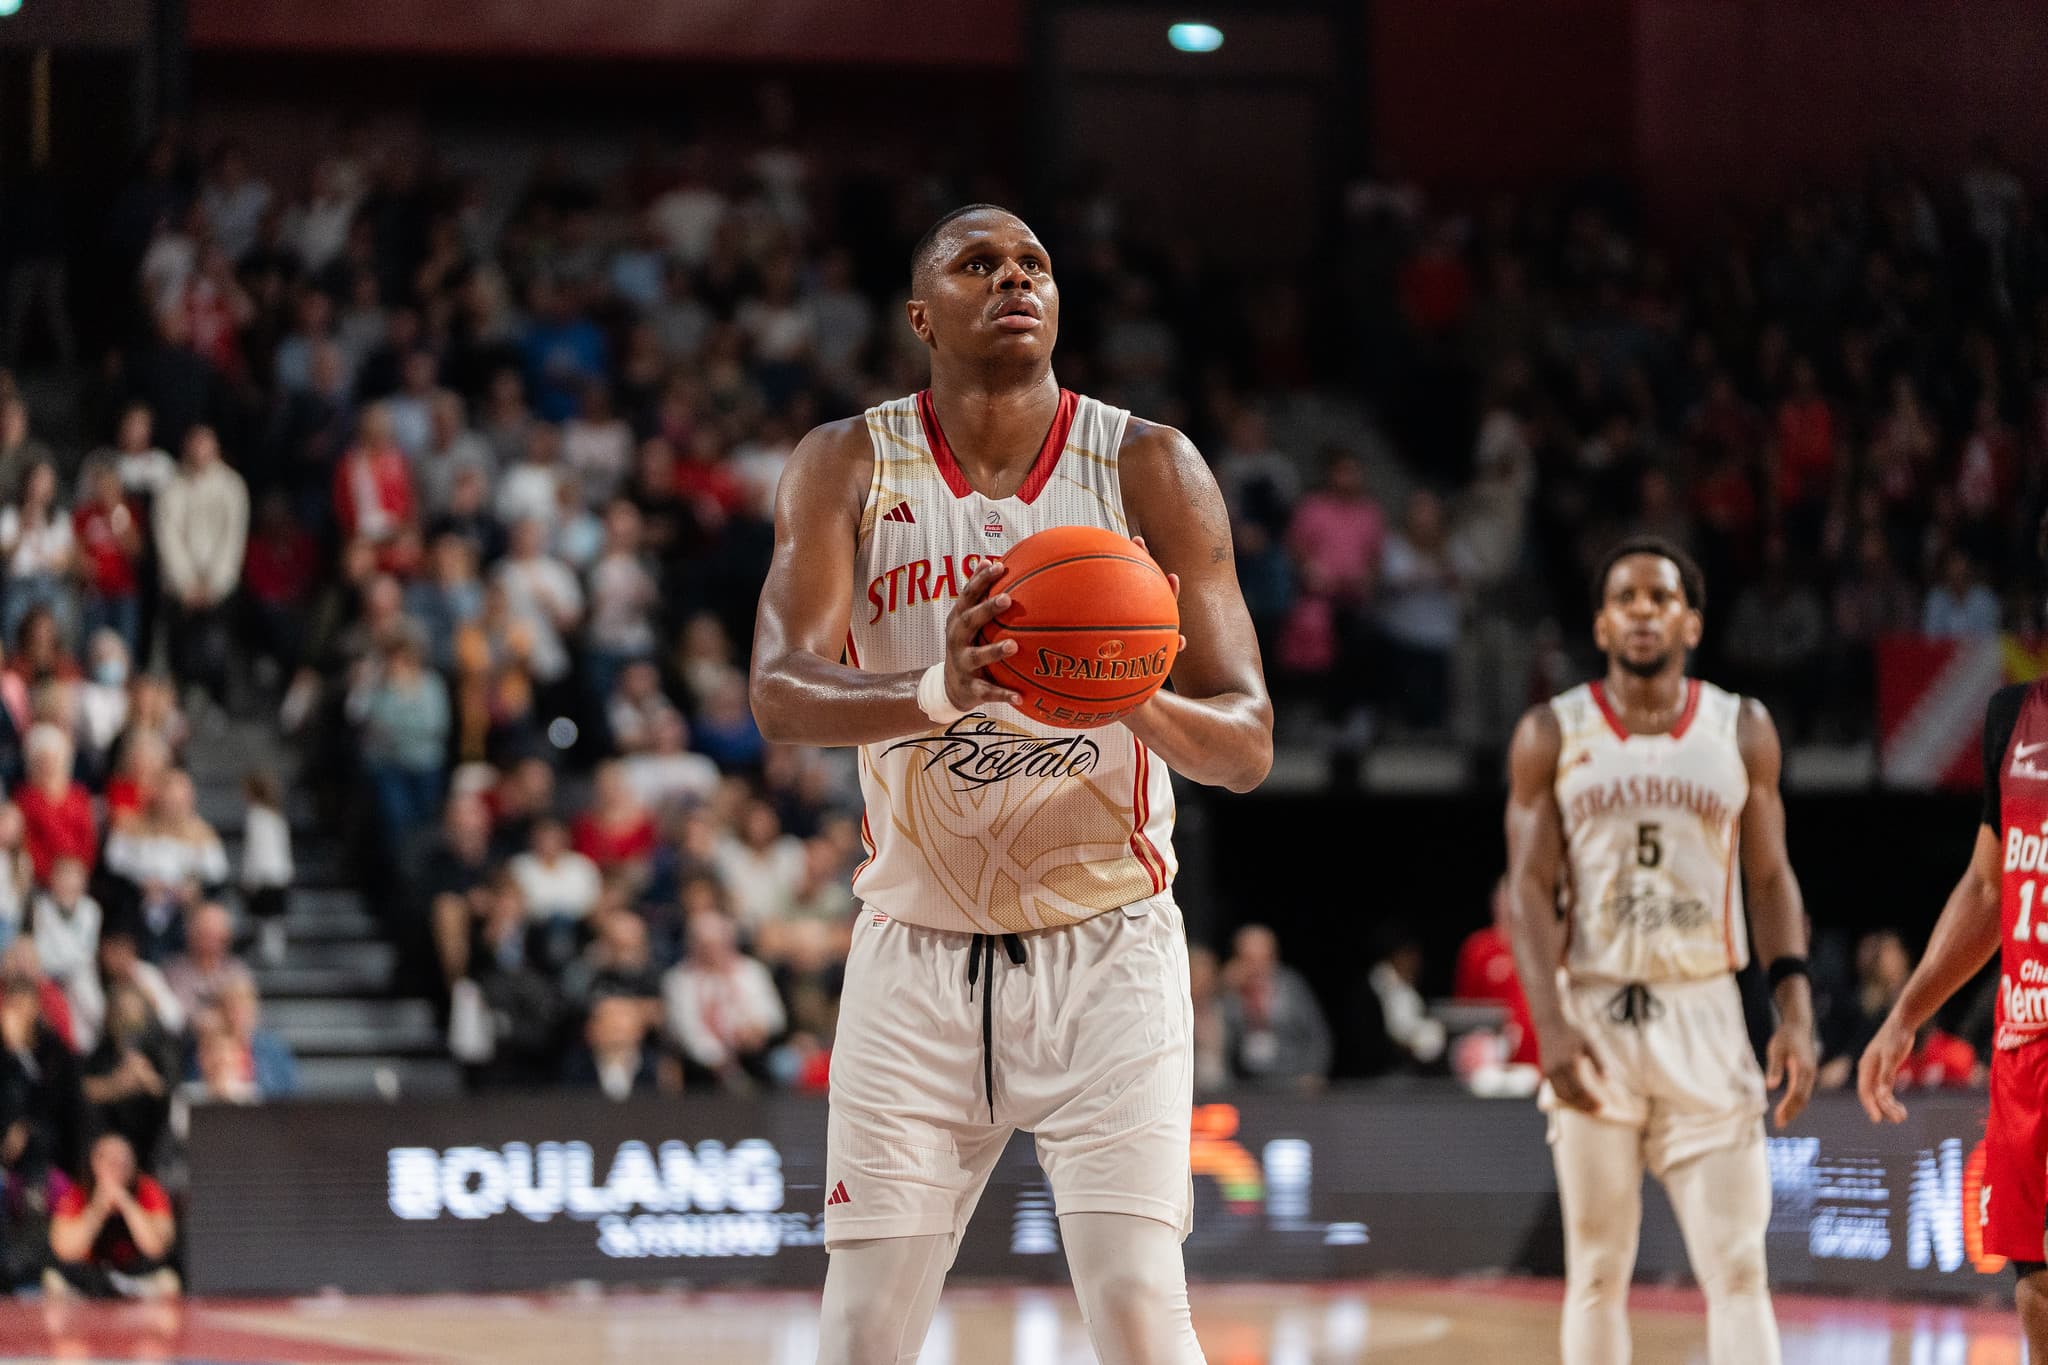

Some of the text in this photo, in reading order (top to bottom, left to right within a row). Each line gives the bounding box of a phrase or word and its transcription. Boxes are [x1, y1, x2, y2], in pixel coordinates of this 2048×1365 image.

[868, 553, 1004, 625] STRAS
[1034, 647, 1167, 681] SPALDING
[880, 734, 1099, 792] Royale
[1636, 821, 1663, 868] 5
